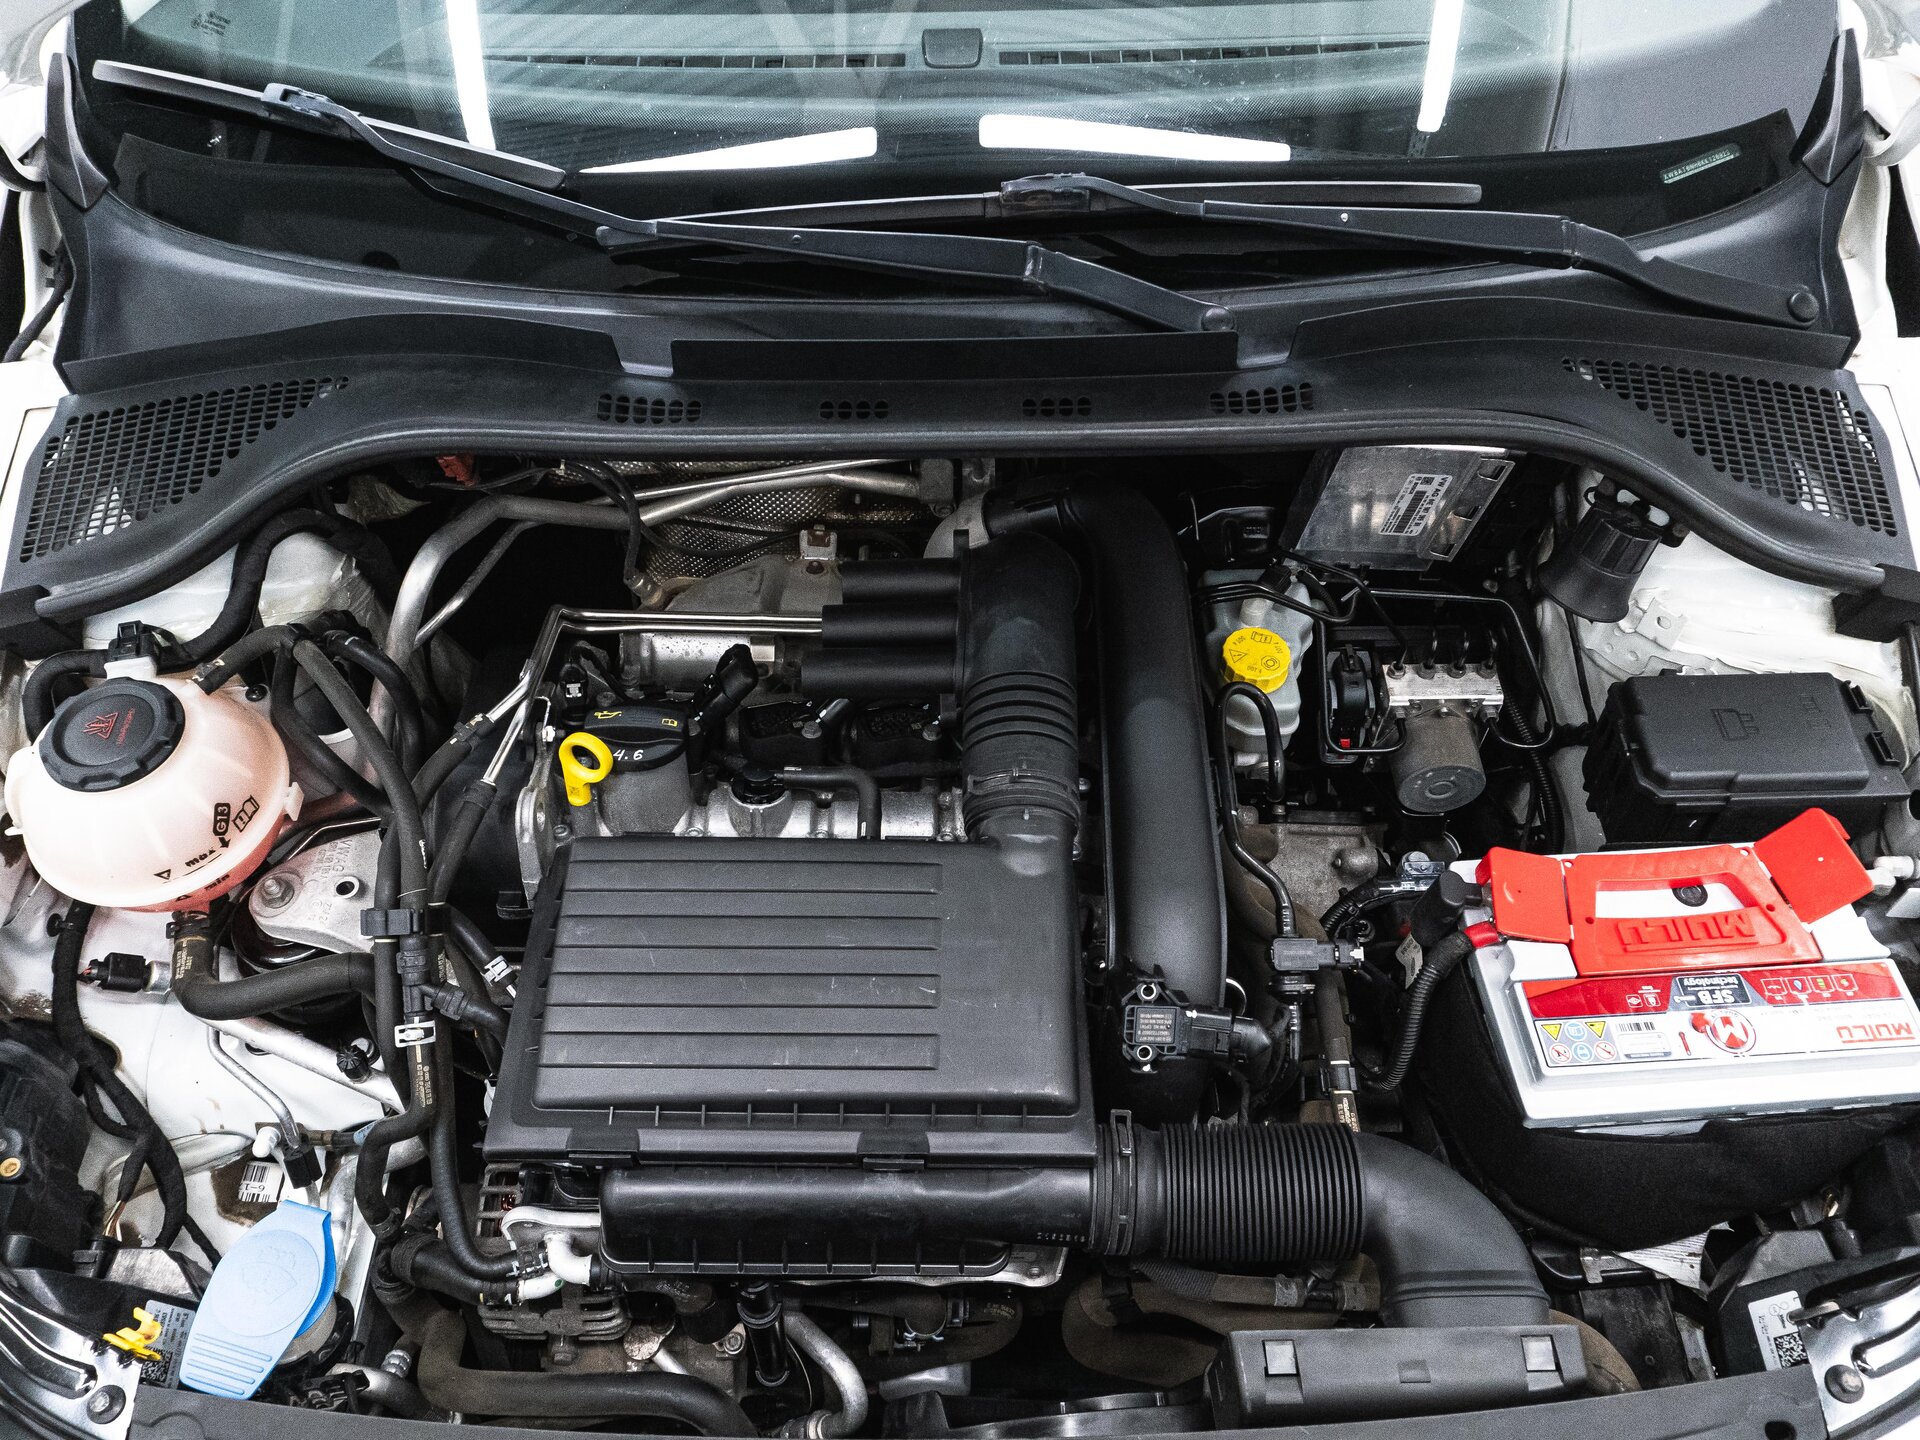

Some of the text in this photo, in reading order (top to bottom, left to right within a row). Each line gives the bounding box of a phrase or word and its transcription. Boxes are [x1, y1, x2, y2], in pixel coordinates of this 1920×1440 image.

[613, 749, 644, 761] 4.6
[216, 806, 228, 832] G13
[1683, 976, 1738, 987] technology
[1697, 990, 1735, 1004] SFB
[1836, 1023, 1916, 1043] MUTLU
